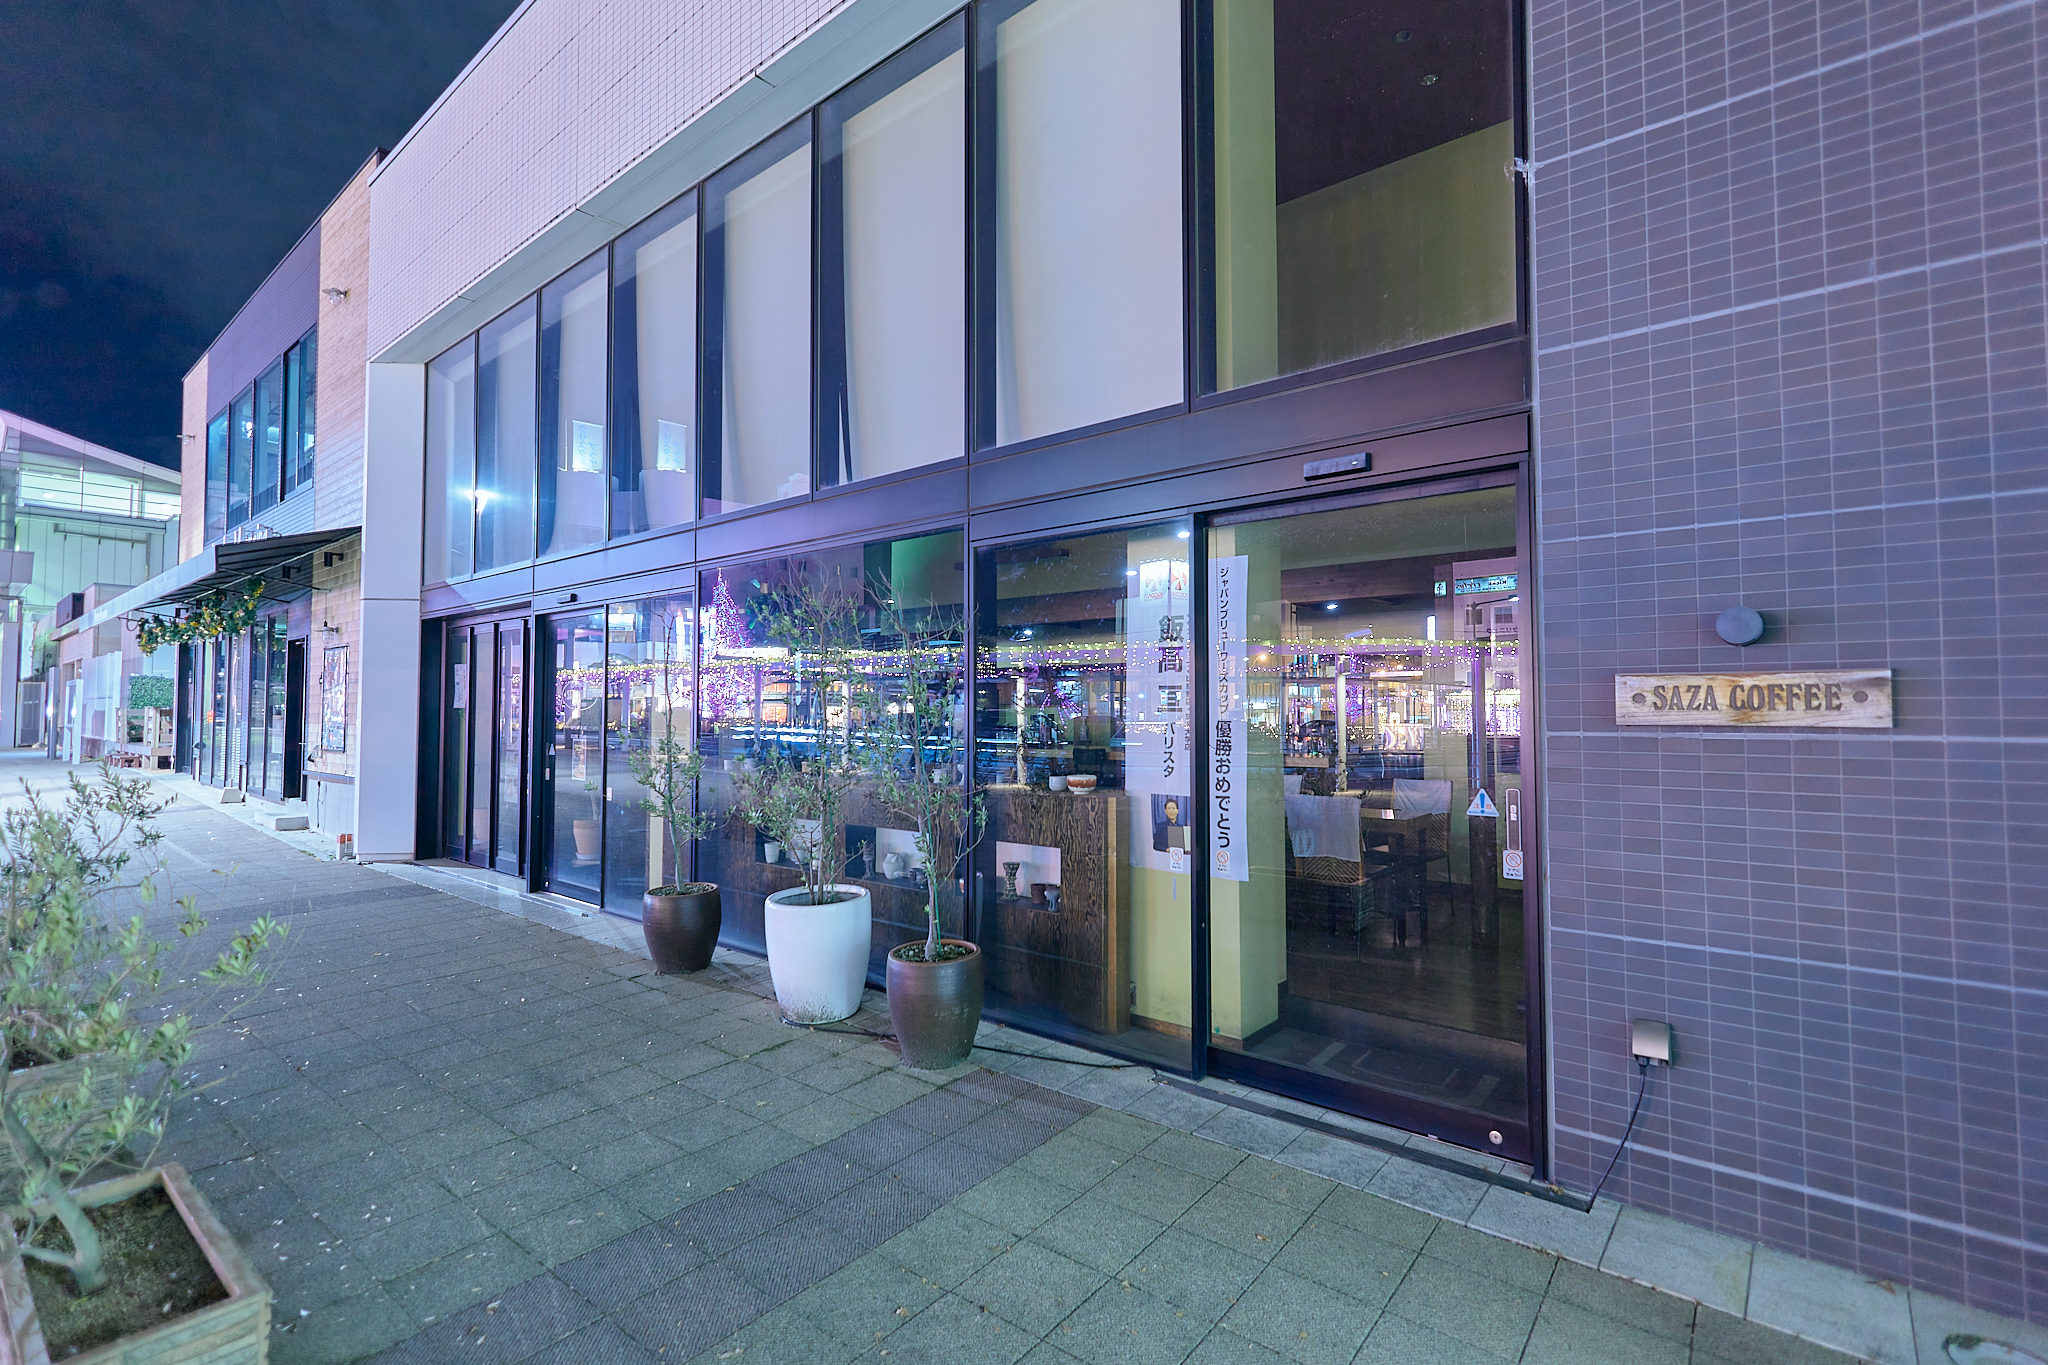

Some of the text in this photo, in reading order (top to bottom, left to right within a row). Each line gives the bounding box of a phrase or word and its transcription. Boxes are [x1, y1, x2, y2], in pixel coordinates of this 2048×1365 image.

[1653, 683, 1843, 711] SAZA COFFEE
[1214, 720, 1232, 848] 優勝おめでとう
